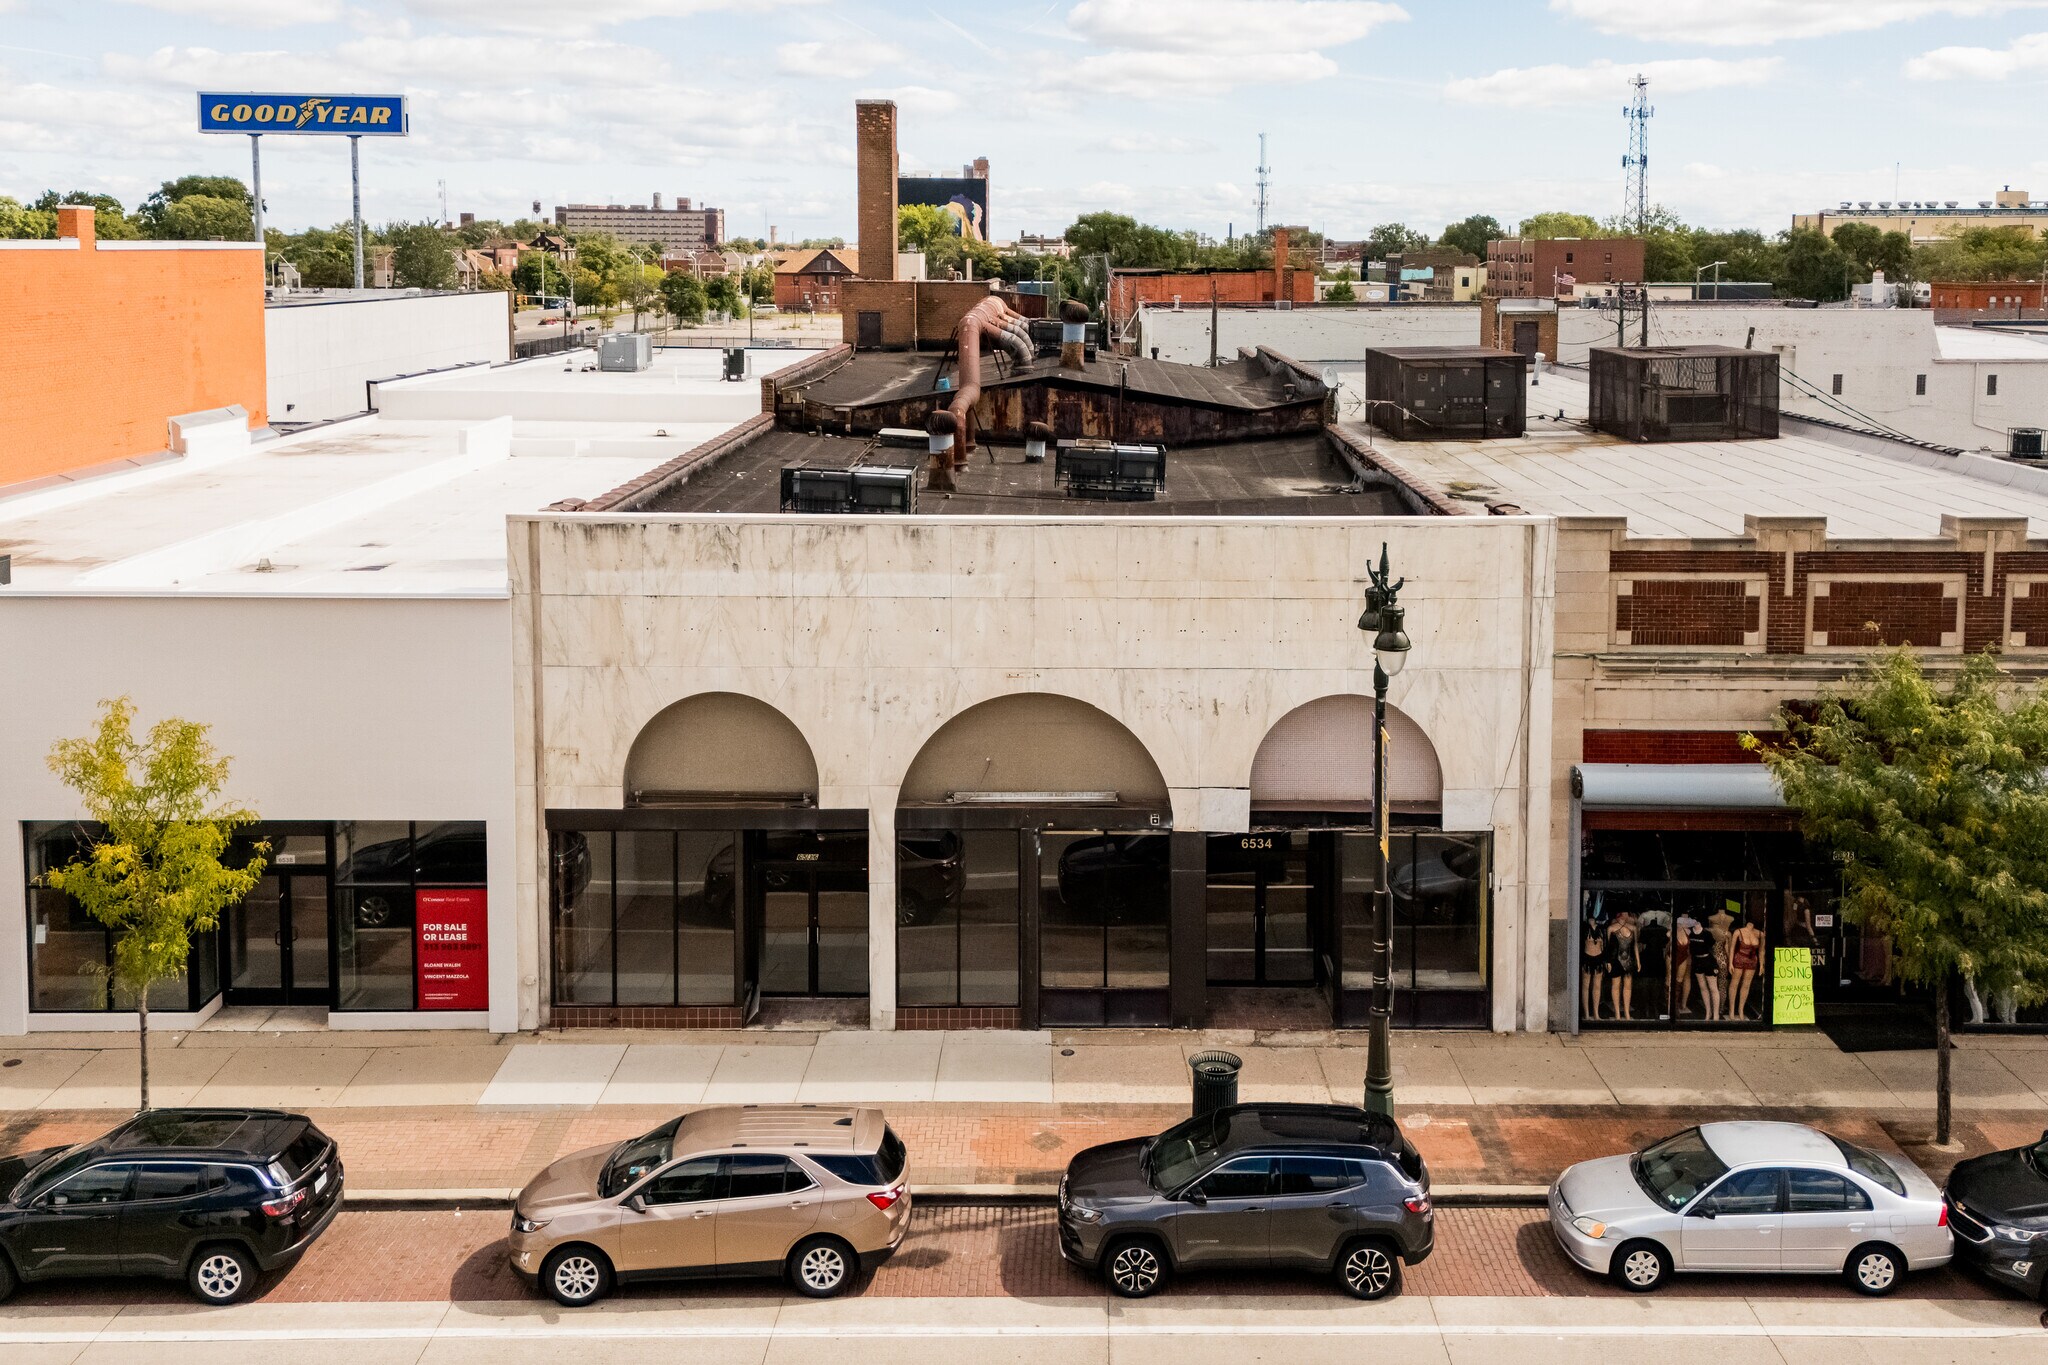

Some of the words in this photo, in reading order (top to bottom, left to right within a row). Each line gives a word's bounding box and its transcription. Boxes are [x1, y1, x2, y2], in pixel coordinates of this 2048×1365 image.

[1241, 838, 1272, 849] 6534
[423, 923, 442, 931] FOR
[444, 923, 467, 931] SALE
[423, 933, 437, 941] OR
[439, 933, 467, 941] LEASE
[1774, 948, 1809, 963] TORE
[1811, 954, 1826, 966] EN
